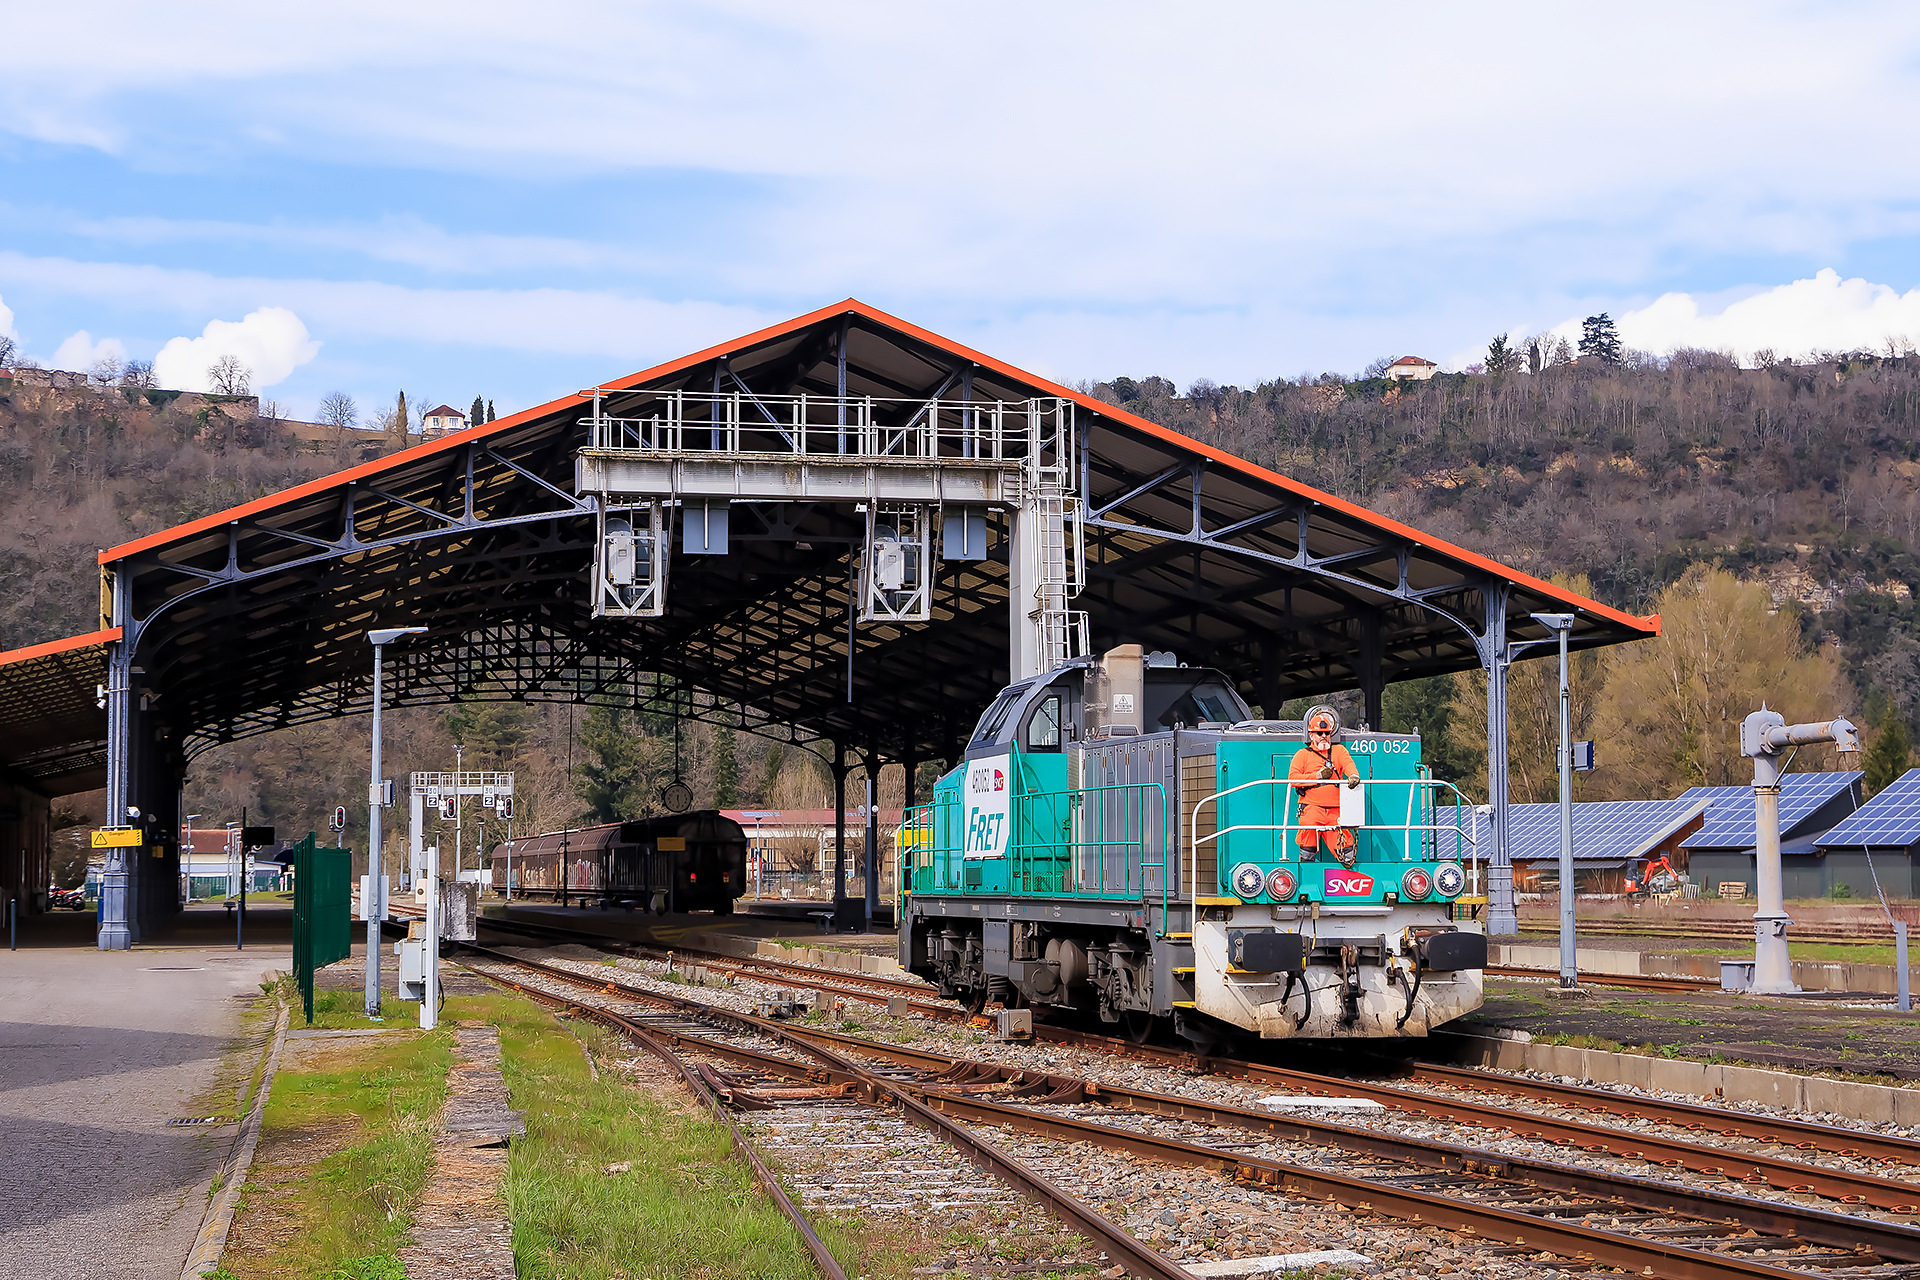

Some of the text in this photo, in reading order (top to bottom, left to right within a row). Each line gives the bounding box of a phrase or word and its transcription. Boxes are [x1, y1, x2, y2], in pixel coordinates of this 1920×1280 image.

[1350, 739, 1410, 754] 460 052
[428, 787, 437, 795] 30
[1326, 878, 1372, 893] SNCF
